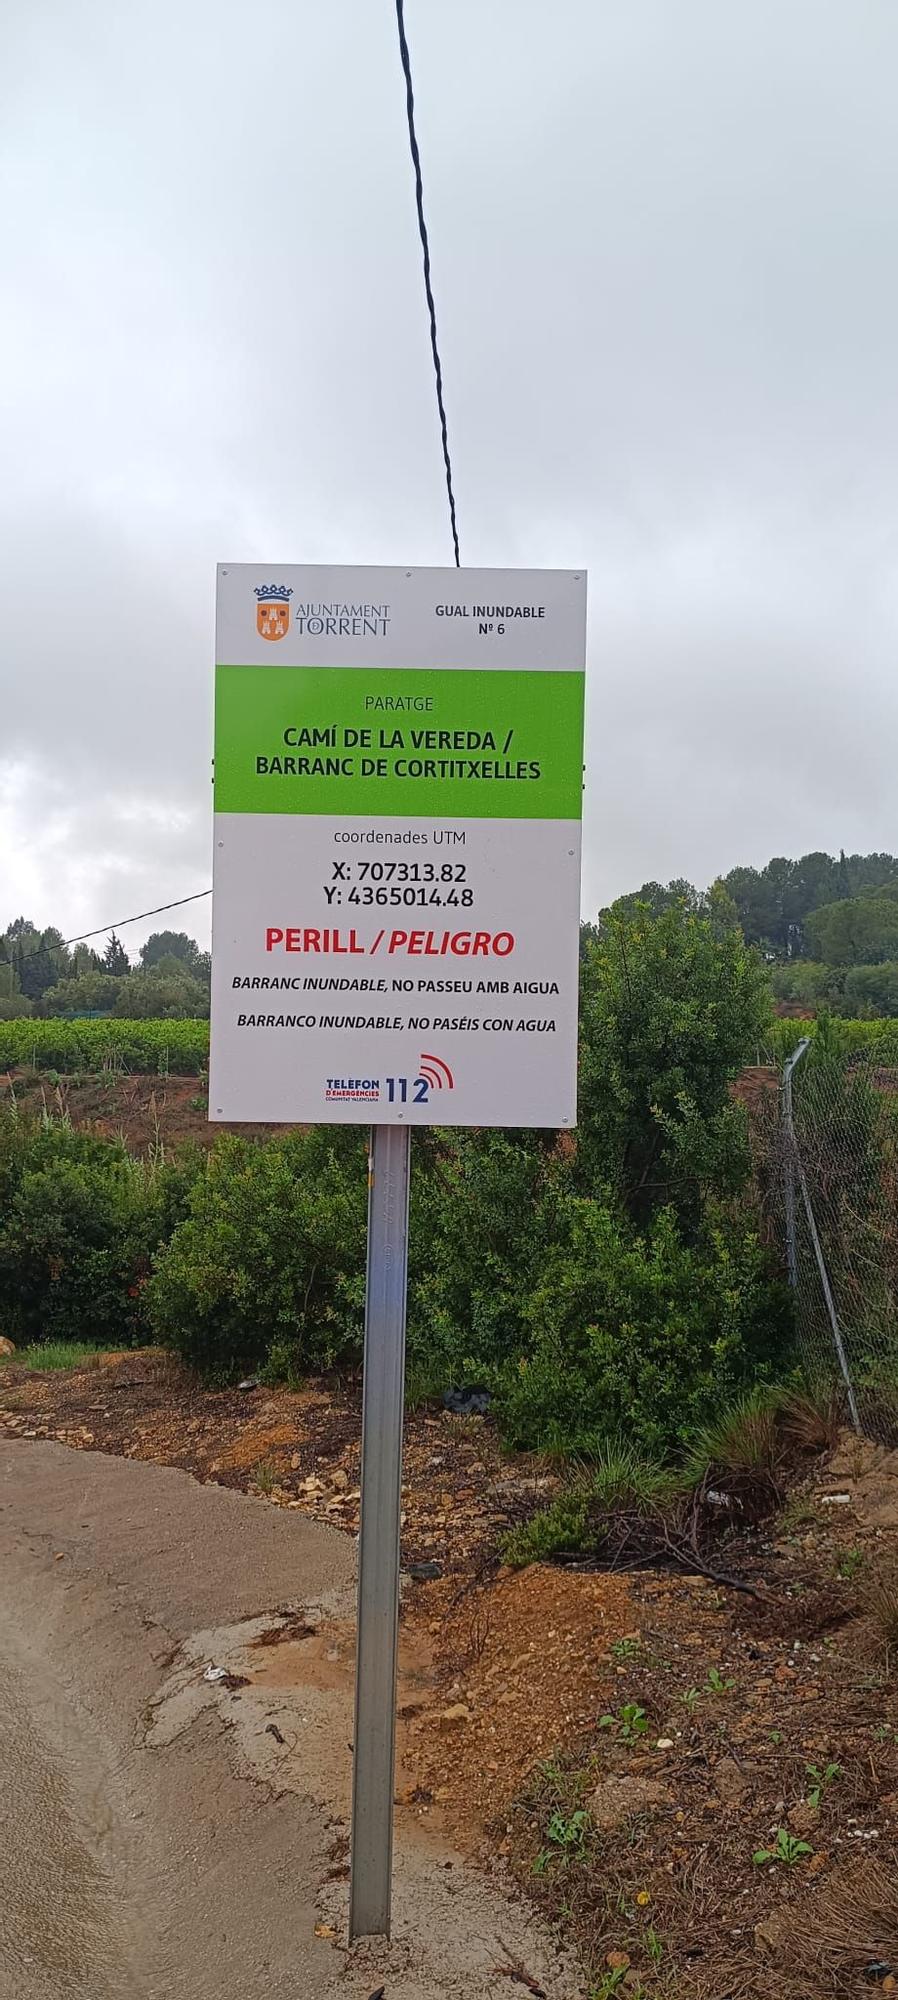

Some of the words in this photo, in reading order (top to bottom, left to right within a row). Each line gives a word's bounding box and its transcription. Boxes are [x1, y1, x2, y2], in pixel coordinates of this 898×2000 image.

[297, 603, 391, 617] AJUNTAMENT
[435, 604, 470, 618] GUAL
[472, 605, 546, 618] INUNDABLE
[296, 617, 391, 636] TORRENT
[497, 623, 506, 635] 6
[365, 696, 434, 711] PARATGE
[283, 724, 337, 747] CAMÍ
[344, 729, 372, 748] DE
[379, 730, 405, 749] LA
[410, 731, 496, 751] VEREDA
[502, 729, 515, 755] /
[256, 756, 354, 775] BARRANC
[361, 758, 388, 777] DE
[394, 759, 541, 780] CORTITXELLES
[334, 829, 428, 845] coordenades
[433, 830, 467, 846] UTM
[331, 861, 352, 881] X:
[357, 862, 467, 884] 707313.82
[323, 886, 342, 905] Y:
[347, 886, 474, 907] 4365014.48
[266, 927, 365, 953] PERILL
[369, 929, 386, 956] /
[387, 930, 515, 957] PELIGRO
[231, 976, 301, 991] BARRANC
[302, 977, 389, 994] INUNDABLE,
[391, 980, 415, 993] NO
[417, 980, 473, 994] PASSEU
[475, 981, 510, 995] AMB
[512, 981, 560, 995] AIGUA
[236, 1014, 317, 1029] BARRANCO
[318, 1015, 405, 1032] INUNDABLE,
[407, 1017, 430, 1031] NO
[432, 1015, 480, 1032] PASÉIS
[481, 1018, 514, 1032] CON
[515, 1019, 557, 1032] AGUA
[385, 1078, 429, 1103] 112
